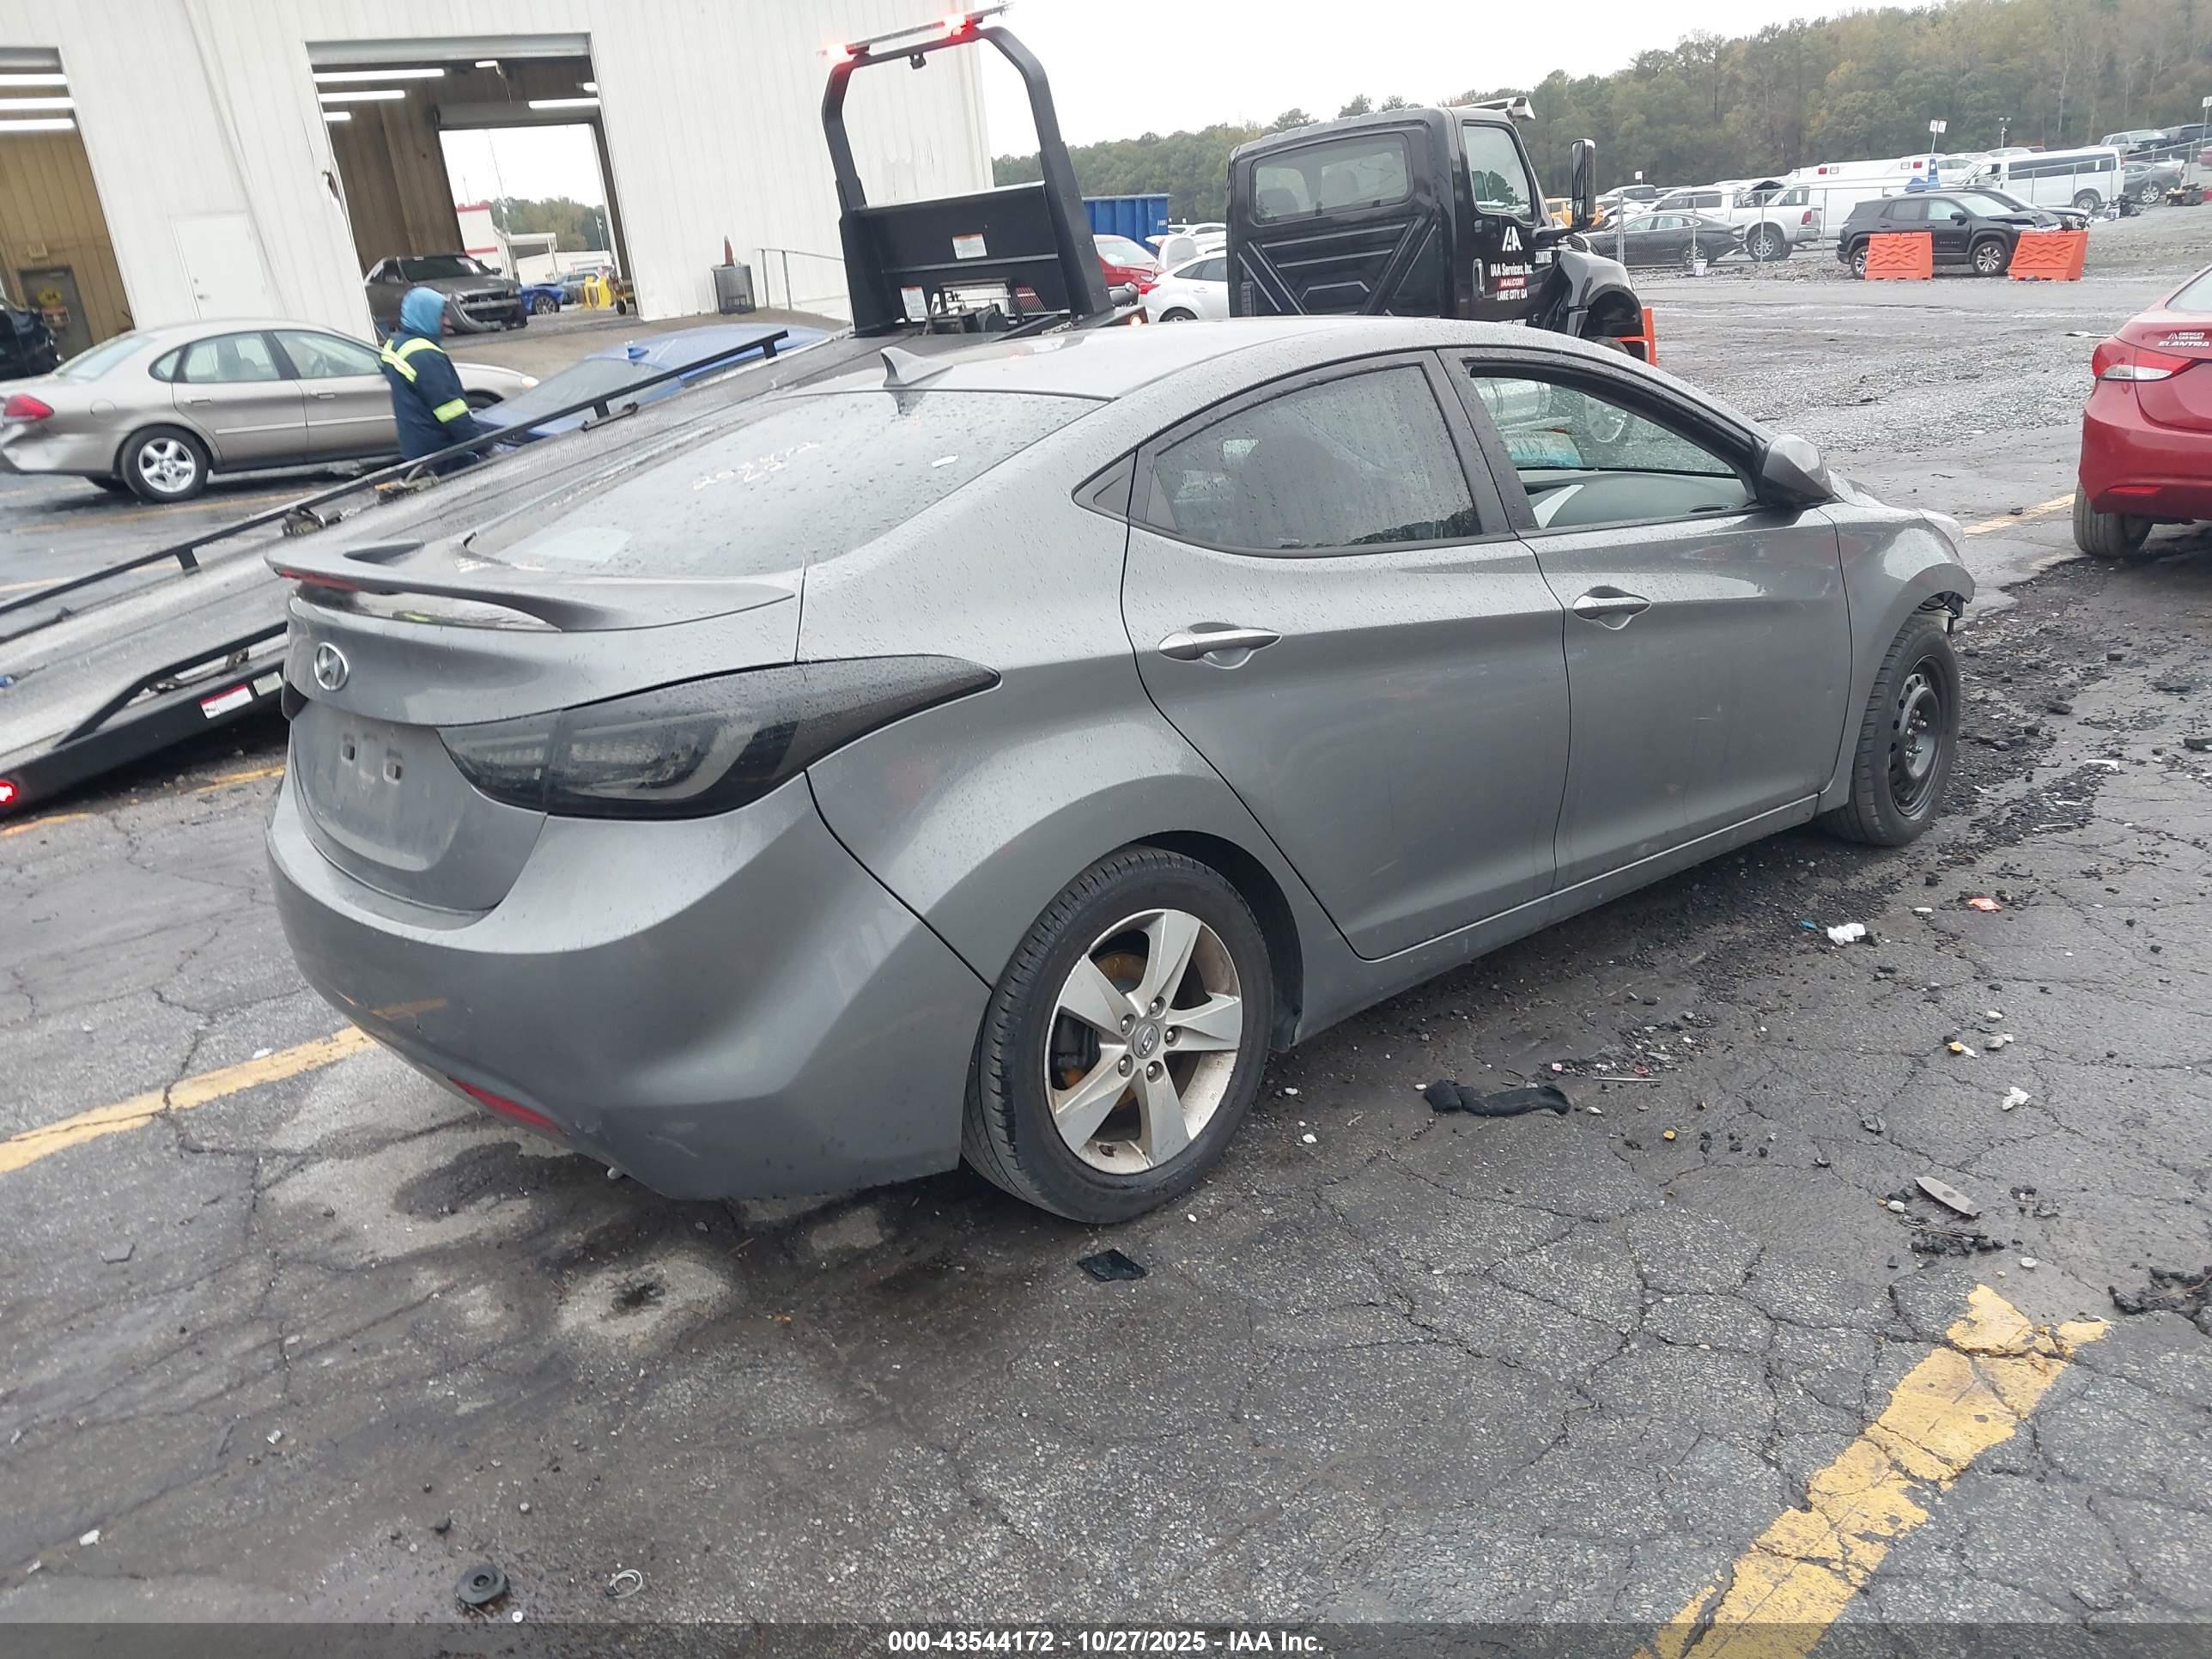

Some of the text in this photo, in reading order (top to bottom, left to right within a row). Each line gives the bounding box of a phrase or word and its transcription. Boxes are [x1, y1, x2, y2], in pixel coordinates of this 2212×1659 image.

[1491, 264, 1502, 276] IAA
[1502, 262, 1524, 276] Services,
[1498, 288, 1528, 301] LAKE CITY, GA
